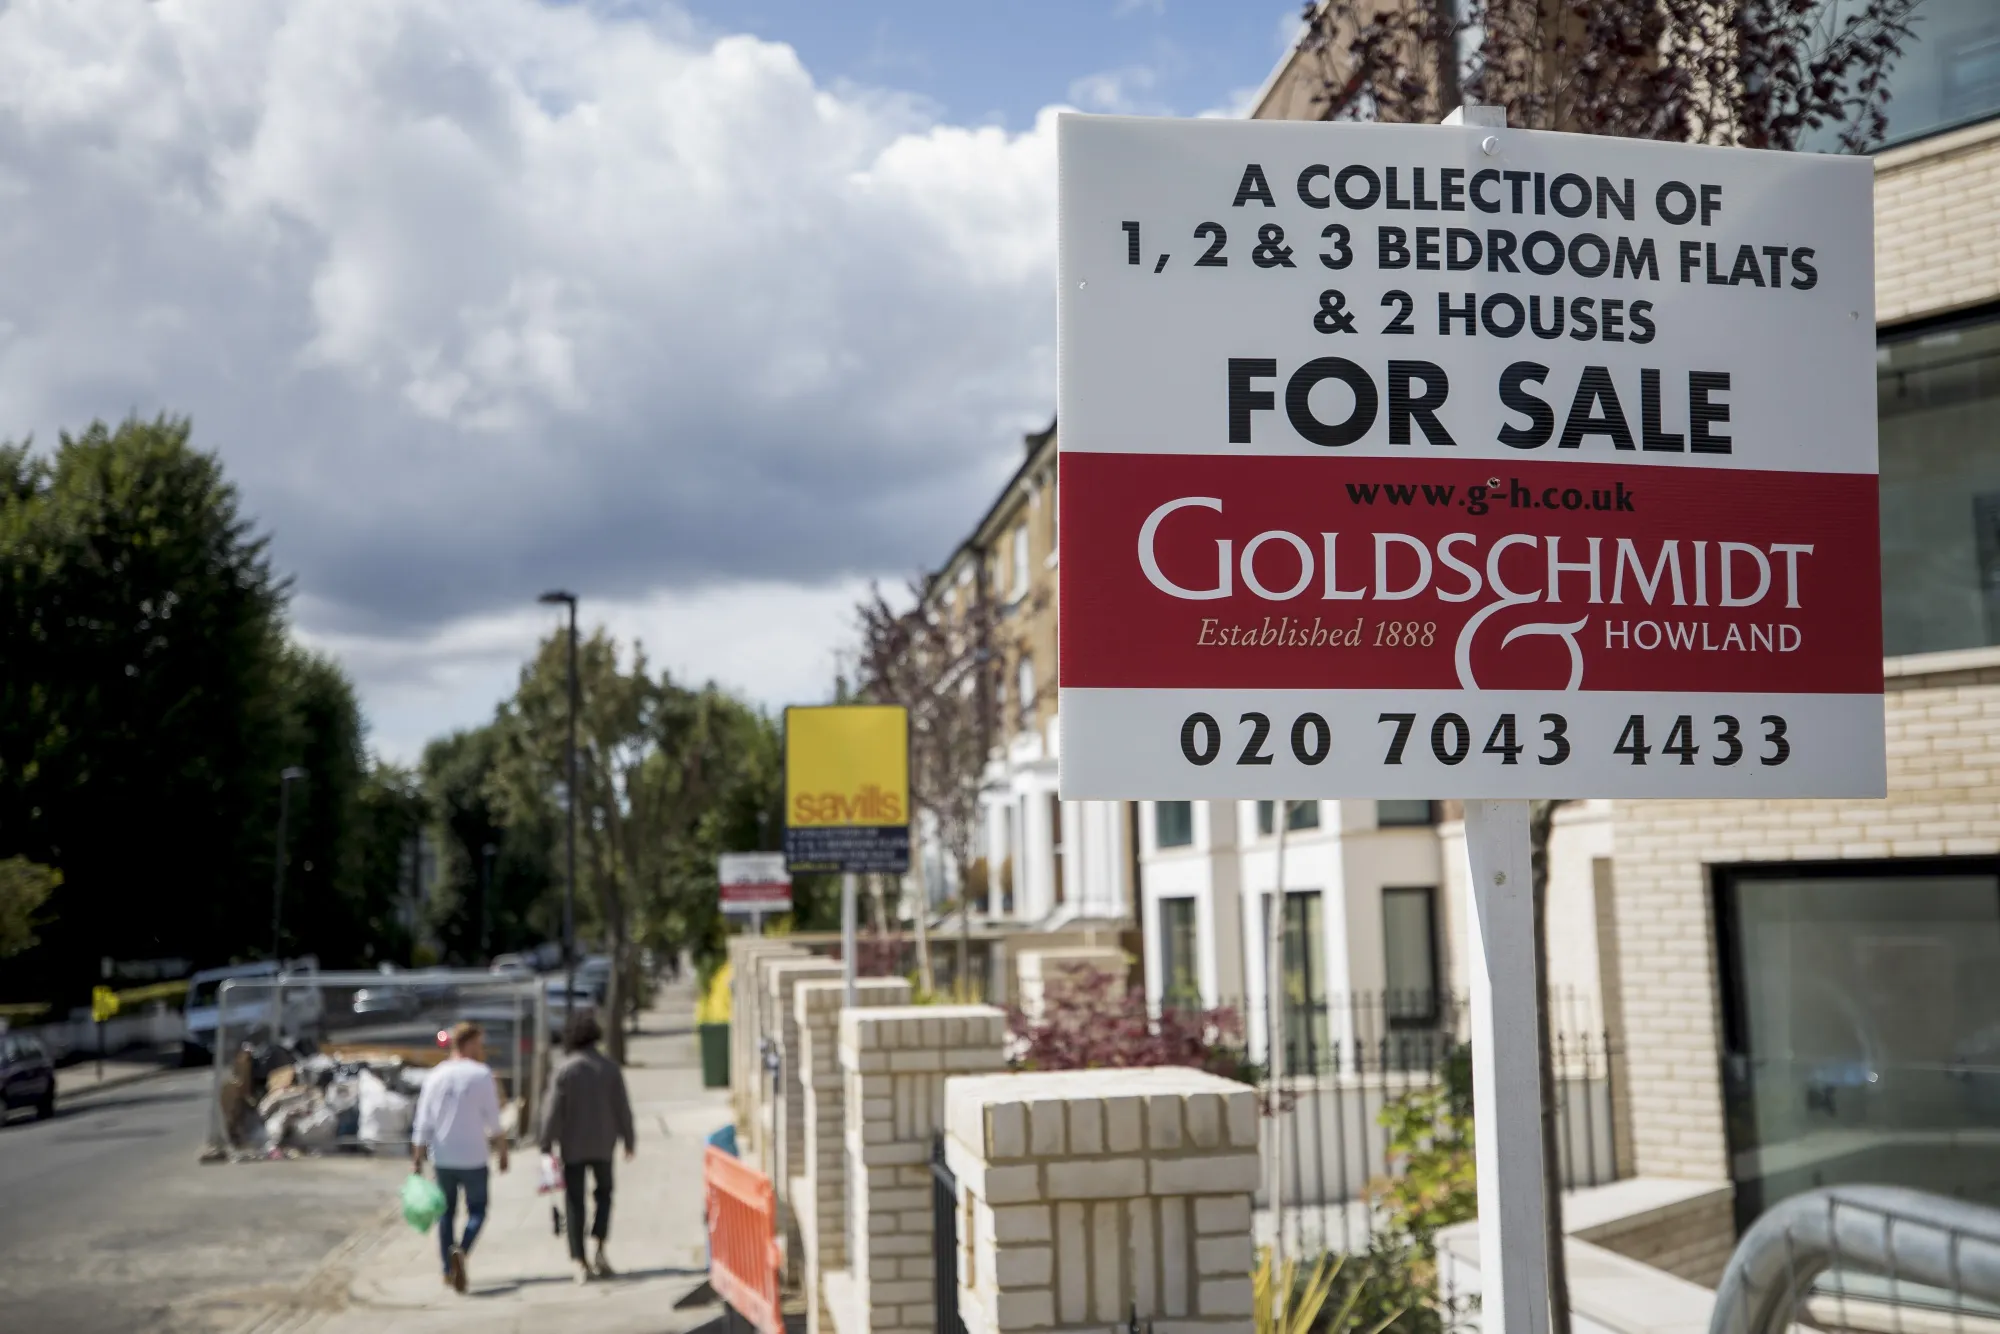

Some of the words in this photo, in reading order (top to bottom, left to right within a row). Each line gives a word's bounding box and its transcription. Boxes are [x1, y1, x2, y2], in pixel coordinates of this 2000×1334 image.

[1232, 164, 1276, 207] A
[1297, 164, 1634, 221] COLLECTION
[1656, 181, 1722, 226] OF
[1122, 221, 1170, 273] 1,
[1194, 222, 1227, 266] 2
[1252, 223, 1297, 268] &
[1319, 224, 1353, 270] 3
[1379, 226, 1659, 280] BEDROOM
[1680, 241, 1818, 290] FLATS
[1314, 289, 1358, 334] &
[1381, 290, 1414, 334] 2
[1439, 292, 1655, 344] HOUSES
[1228, 357, 1457, 447] FOR
[1497, 361, 1732, 454] SALE
[1345, 478, 1635, 515] www.g-h.co.uk
[1138, 497, 1814, 609] GOLDSCHMIDT
[1197, 617, 1363, 646] Established
[1373, 622, 1436, 646] 1888
[1606, 621, 1801, 652] HOWLAND
[1181, 712, 1330, 766] 020
[1378, 713, 1570, 765] 7043
[1613, 715, 1790, 766] 4433
[794, 783, 902, 823] savills
